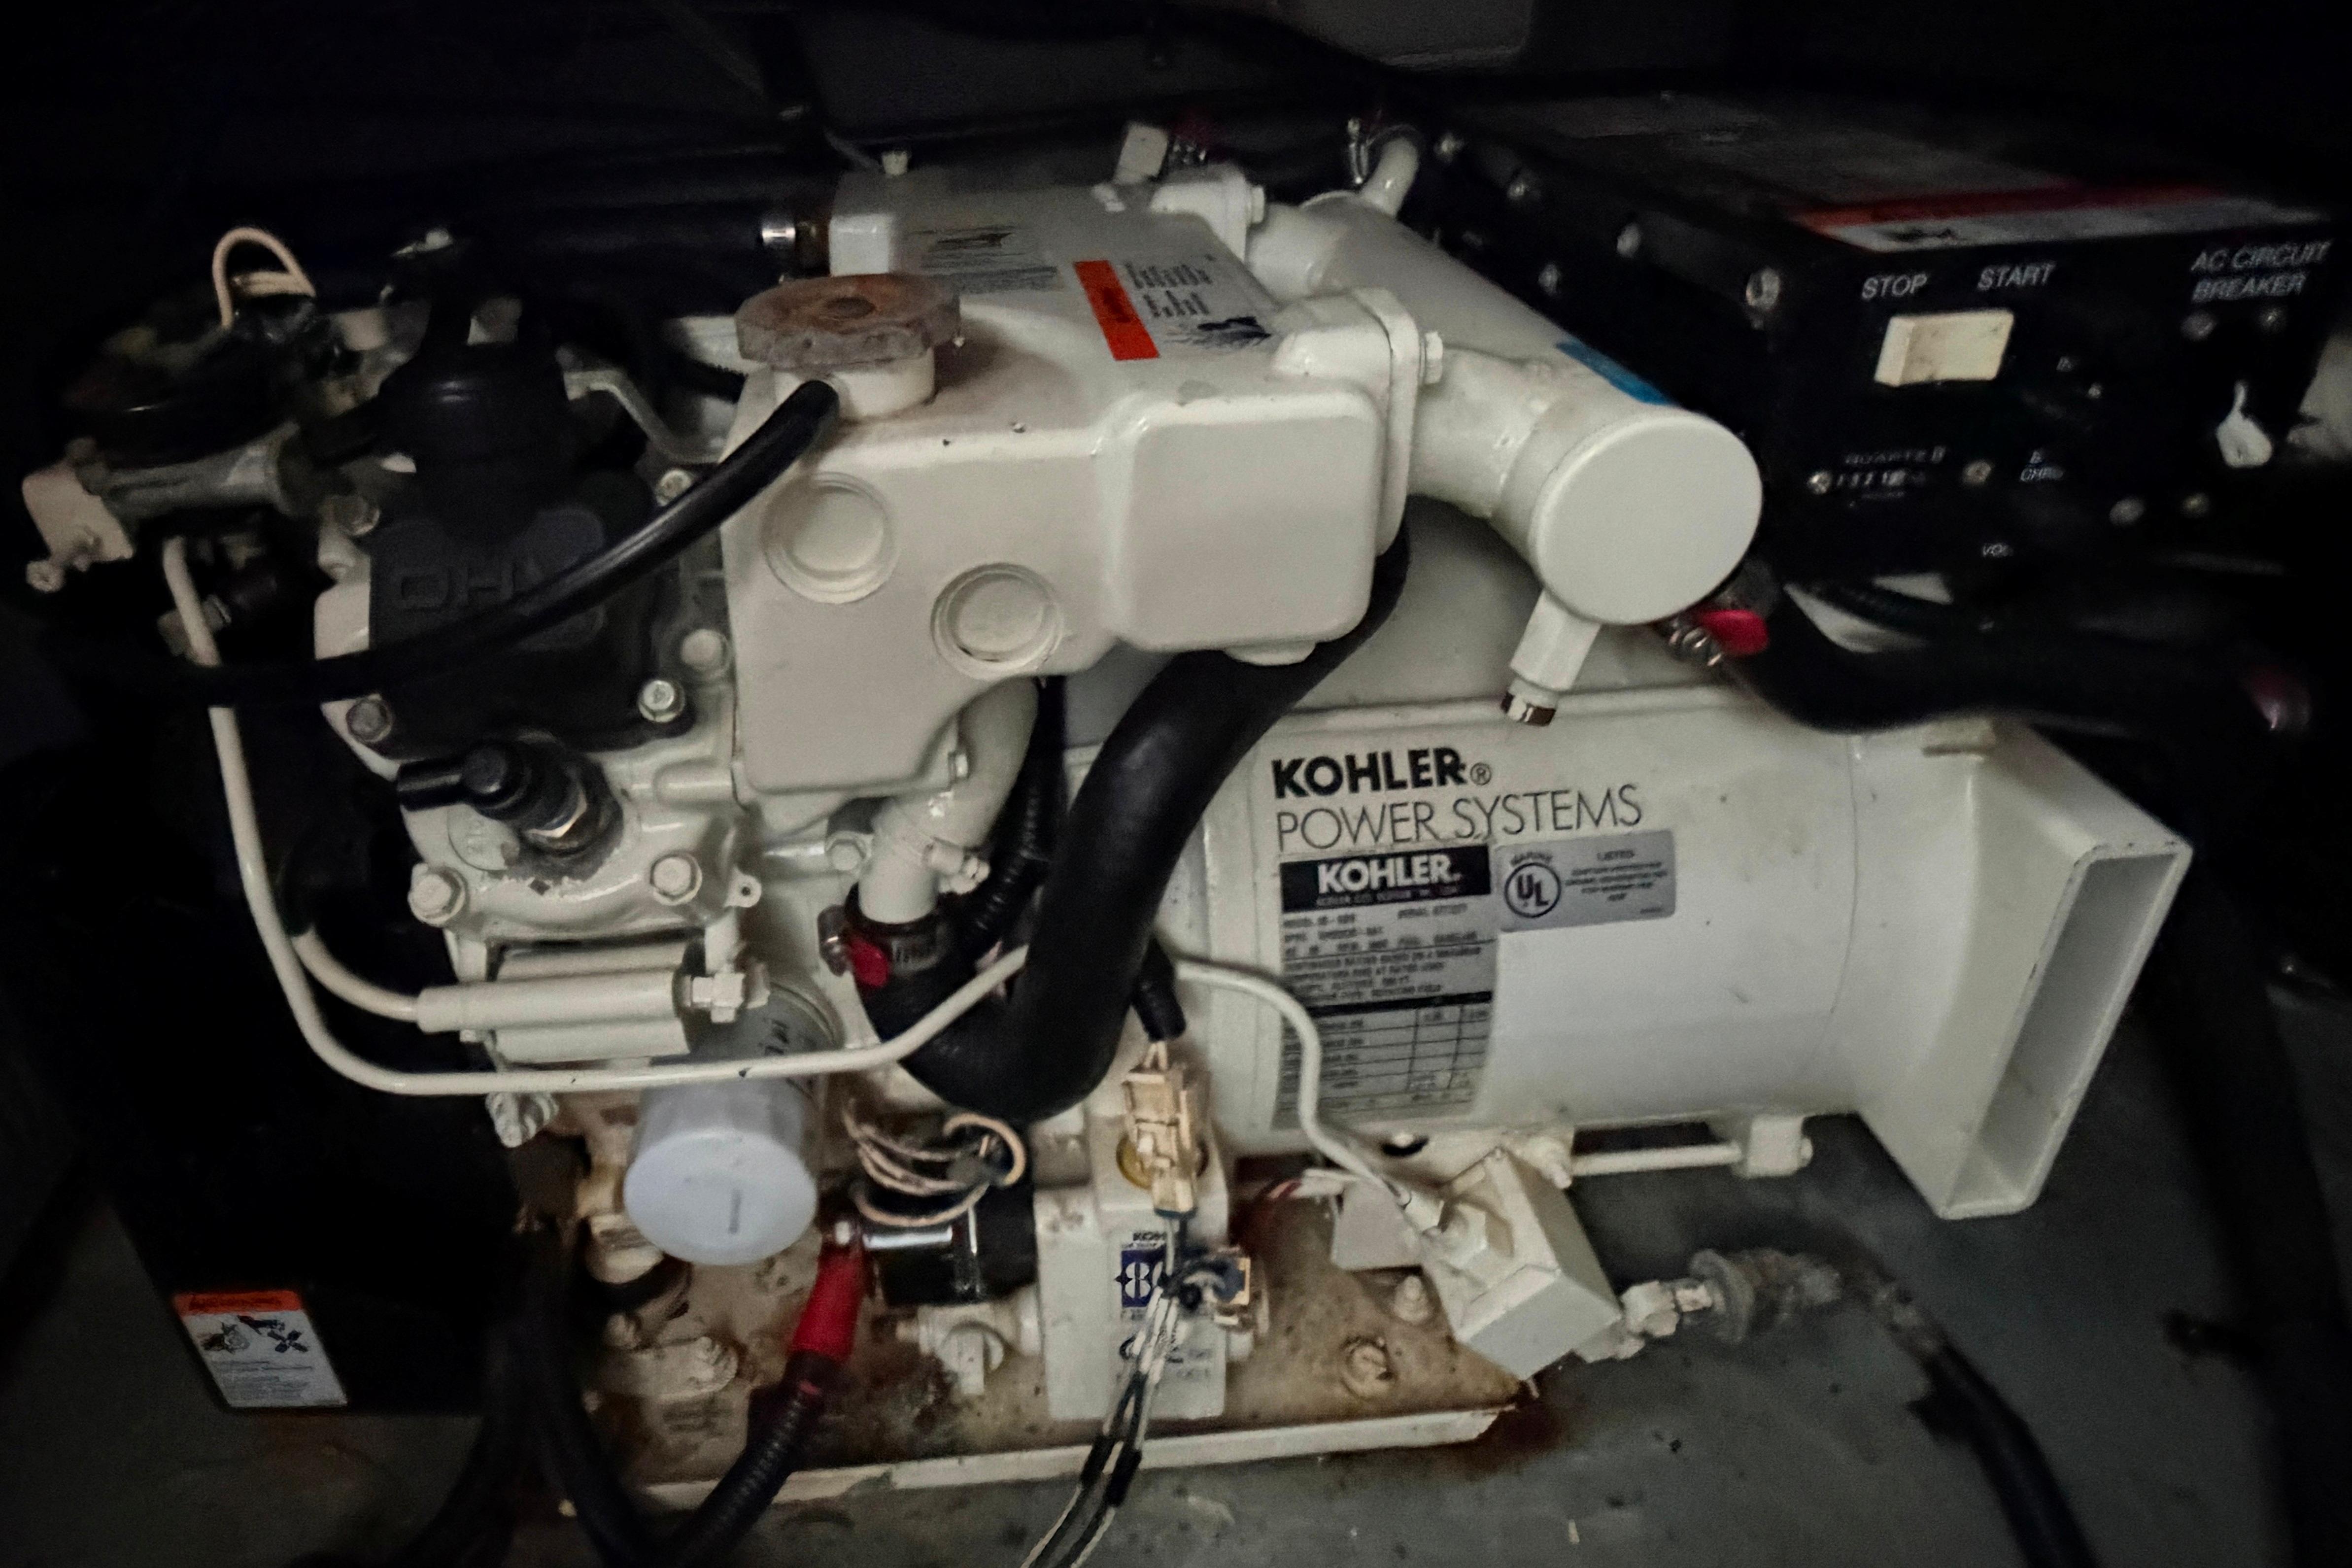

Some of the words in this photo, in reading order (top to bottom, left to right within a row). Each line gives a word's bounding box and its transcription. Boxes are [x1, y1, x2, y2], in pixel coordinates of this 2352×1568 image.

[1977, 260, 2057, 292] START
[2191, 247, 2228, 274] AC
[1860, 271, 1928, 301] STOP
[1277, 802, 1440, 852] POWER
[1452, 784, 1641, 841] SYSTEMS
[1516, 873, 1549, 907] UL
